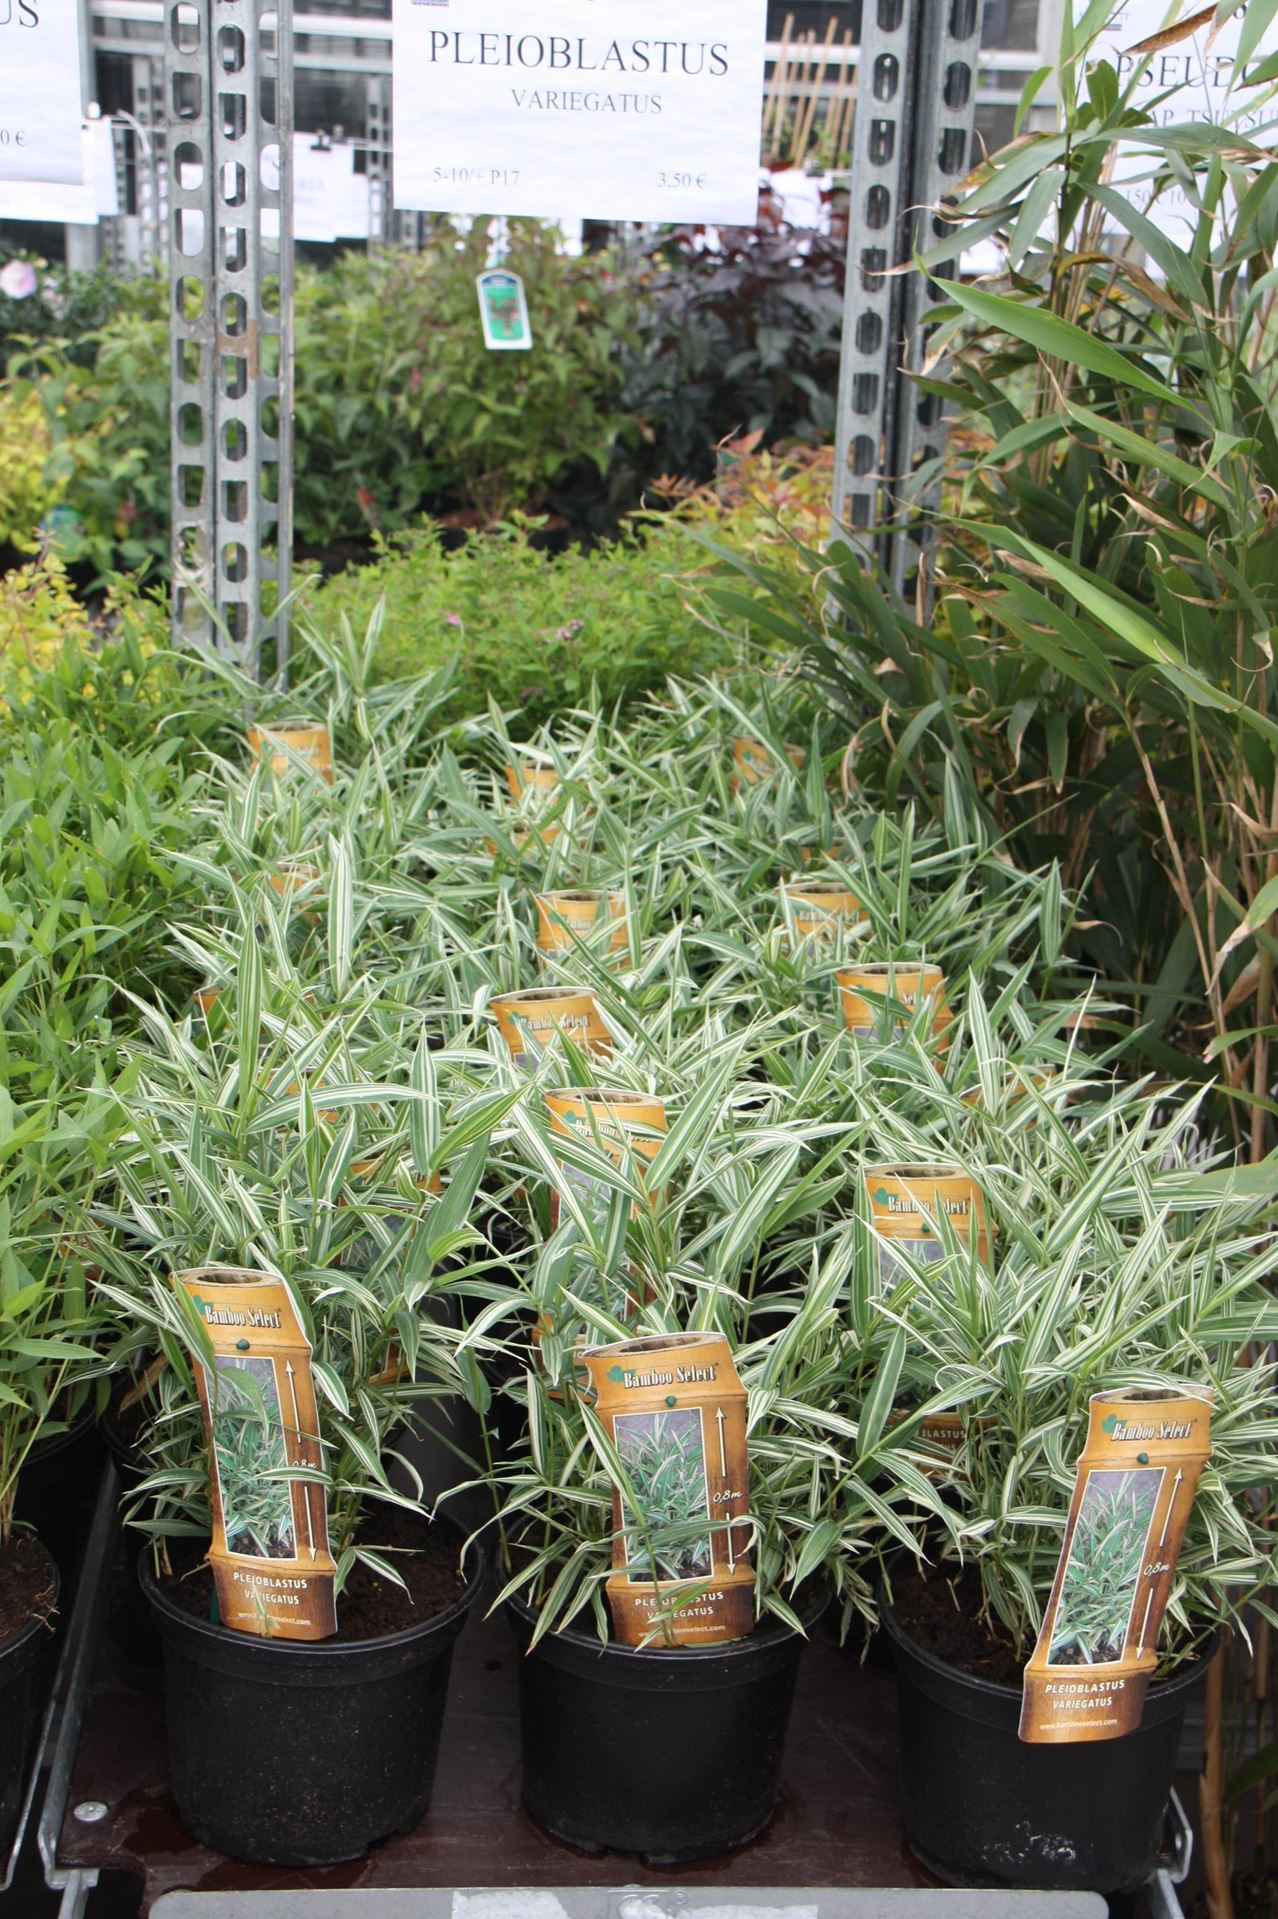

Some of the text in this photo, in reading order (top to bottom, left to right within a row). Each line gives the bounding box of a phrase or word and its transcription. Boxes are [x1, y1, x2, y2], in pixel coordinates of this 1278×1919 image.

[429, 30, 729, 76] PLEIOBLASTUS
[511, 89, 662, 115] VARIEGATUS
[491, 169, 520, 187] P17
[696, 173, 706, 190] €
[204, 1304, 281, 1329] Bamboo Select
[623, 1364, 717, 1389] Bamboo Select
[1111, 1419, 1193, 1441] Bamboo Select
[233, 1572, 308, 1589] PLEIOBLASTUS
[1044, 1679, 1125, 1693] PLEIOBLASTUS
[1052, 1697, 1113, 1709] VARIEGATUS
